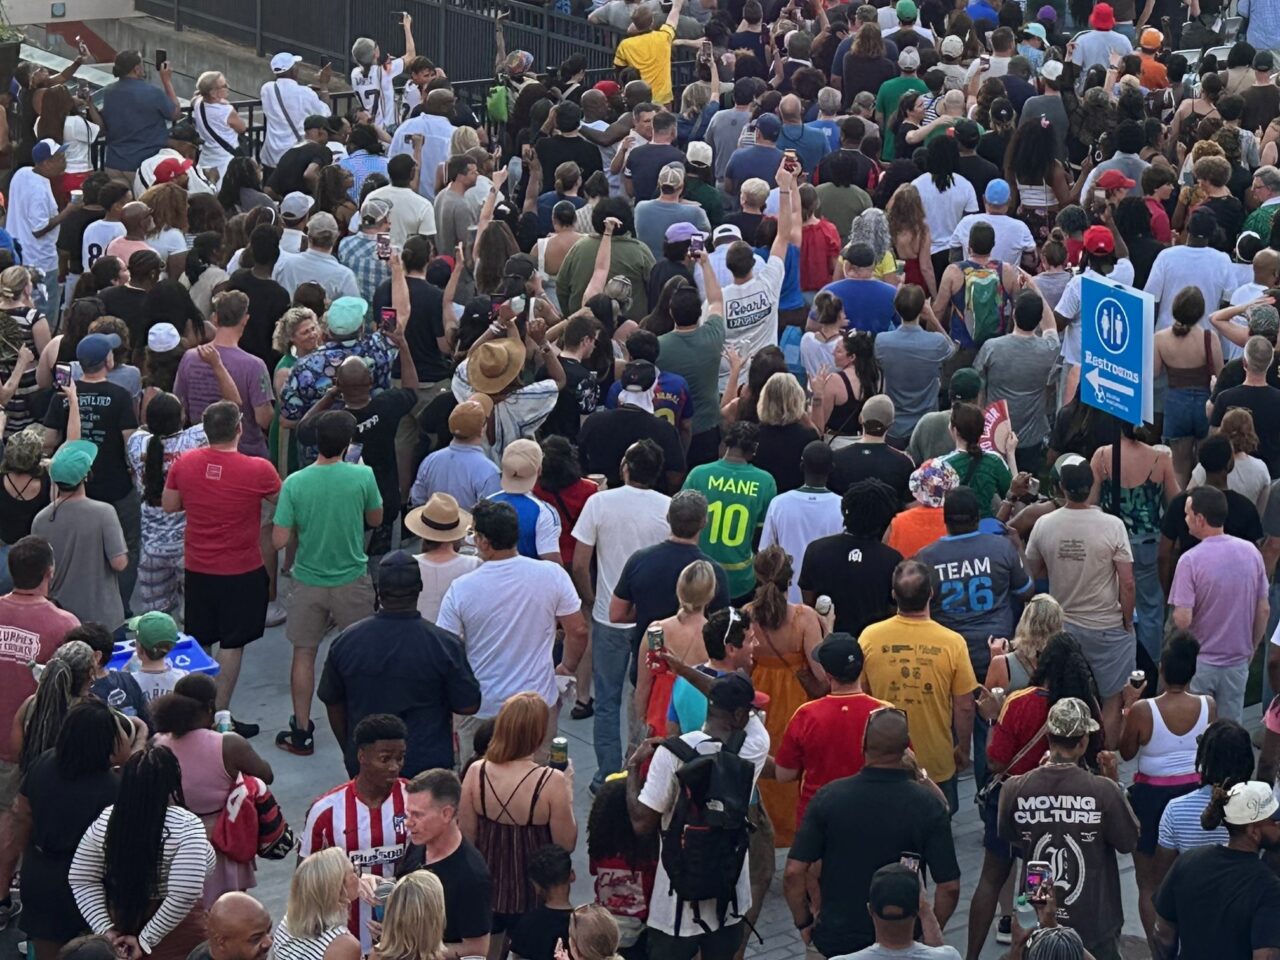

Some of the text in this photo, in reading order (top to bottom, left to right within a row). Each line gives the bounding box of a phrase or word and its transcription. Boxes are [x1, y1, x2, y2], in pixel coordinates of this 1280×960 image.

[729, 293, 768, 317] Roark
[1084, 350, 1139, 384] Restrooms
[708, 475, 760, 497] MANE
[707, 500, 749, 547] 10
[934, 556, 991, 581] TEAM
[941, 576, 993, 613] 26
[1017, 795, 1097, 810] MOVING
[1013, 809, 1103, 825] CULTURE
